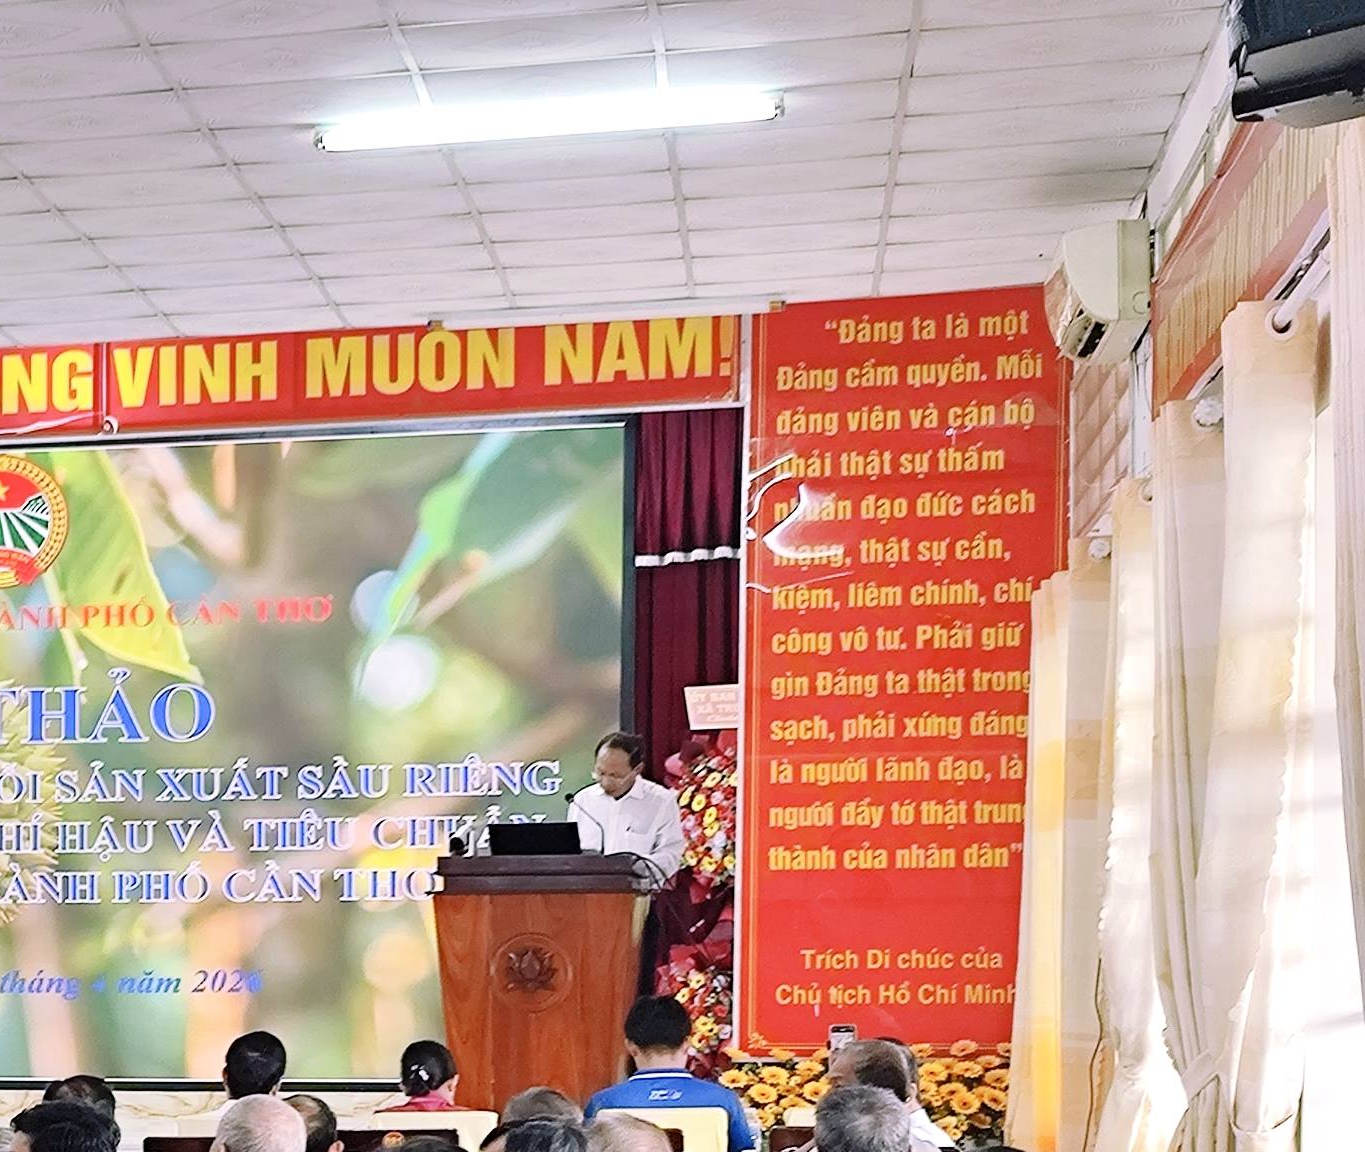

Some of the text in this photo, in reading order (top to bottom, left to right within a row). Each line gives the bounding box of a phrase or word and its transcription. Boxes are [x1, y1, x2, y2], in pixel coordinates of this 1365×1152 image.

[825, 310, 1030, 345] “Đảng ta là một
[113, 339, 278, 408] VINH
[776, 360, 838, 393] Đảng
[776, 397, 1035, 437] đảng viên và cán bộ
[81, 596, 155, 628] PHỐ
[253, 593, 334, 624] THƠ
[771, 618, 1025, 655] công vô tư. Phải giữ
[55, 757, 146, 804] SẢN
[155, 757, 289, 803] XUẤT
[297, 755, 395, 801] SẦU
[403, 754, 563, 799] RIÊNG
[769, 752, 1024, 787] là người lãnh đạo, là
[57, 812, 158, 863] HẬU
[167, 809, 234, 854] VÀ
[243, 808, 366, 854] TIÊU
[768, 841, 1024, 872] thành của nhân dân”
[112, 859, 209, 905] PHỐ
[221, 859, 328, 905] CẦN
[118, 969, 181, 994] năm
